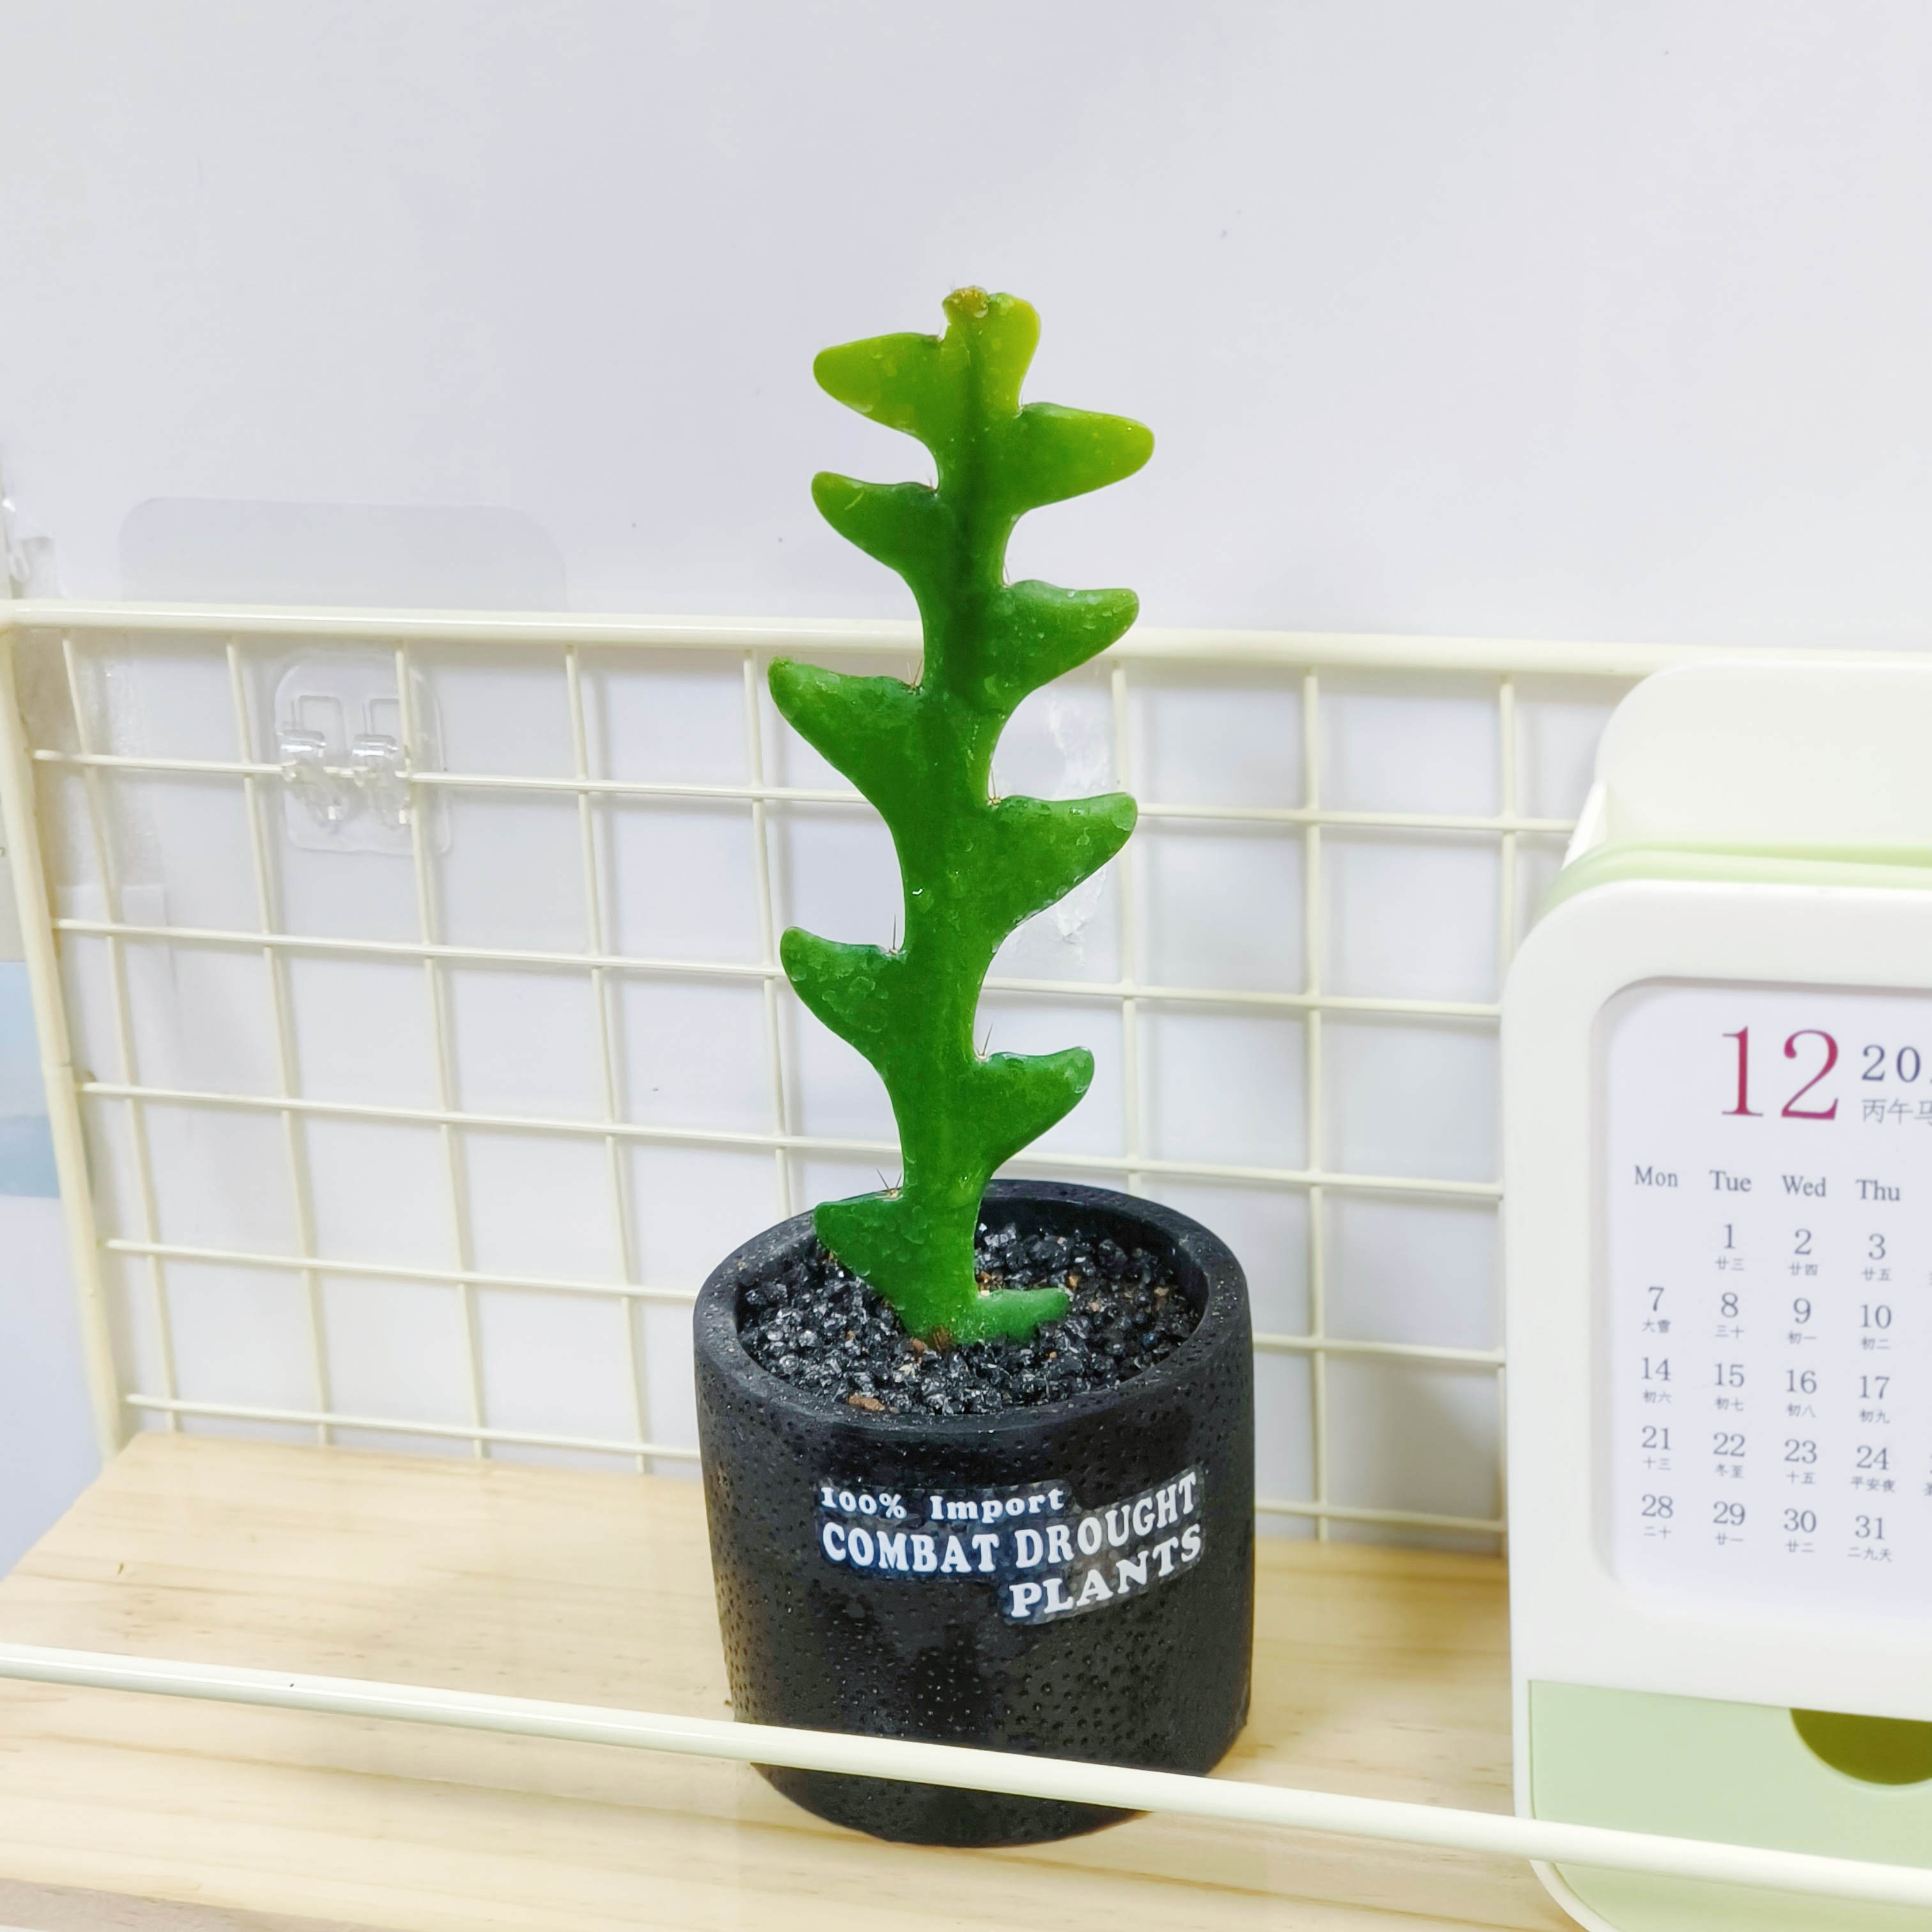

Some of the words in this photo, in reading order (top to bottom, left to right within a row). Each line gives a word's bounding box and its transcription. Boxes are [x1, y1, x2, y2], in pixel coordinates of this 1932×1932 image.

[1721, 1025, 1840, 1122] 12
[1860, 1043, 1932, 1084] 20
[1634, 1164, 1679, 1188] Mon
[1708, 1169, 1752, 1193] Tue
[1781, 1174, 1827, 1198] Wed
[1855, 1178, 1901, 1202] Thu
[1723, 1223, 1736, 1250] 1
[1793, 1227, 1813, 1256] 2
[1867, 1232, 1887, 1261] 3
[1647, 1285, 1666, 1313] 7
[1720, 1291, 1739, 1319] 8
[1792, 1297, 1812, 1325] 9
[1860, 1303, 1893, 1330] 10
[1715, 1324, 1745, 1339] 三十
[1786, 1330, 1817, 1345] 初一
[1860, 1335, 1890, 1351] 初二
[1641, 1356, 1671, 1383] 14
[1714, 1362, 1745, 1388] 15
[1786, 1368, 1818, 1395] 16
[1859, 1374, 1891, 1400] 17
[1714, 1395, 1744, 1412] 初七
[1786, 1402, 1816, 1418] 初八
[1859, 1408, 1890, 1424] 初九
[1641, 1425, 1672, 1451] 21
[1712, 1432, 1746, 1458] 22
[1783, 1438, 1818, 1465] 23
[1855, 1445, 1890, 1471] 24
[1643, 1455, 1671, 1471] 十三
[1714, 1462, 1744, 1479] 冬至
[1786, 1470, 1815, 1485] 十五
[1850, 1476, 1896, 1493] 平安夜
[820, 1486, 907, 1519] 100%
[929, 1489, 1064, 1524] Import
[822, 1521, 1000, 1574] COMBAT
[1013, 1471, 1197, 1569] DROUGHT
[1641, 1493, 1674, 1519] 28
[1712, 1500, 1747, 1527] 29
[1783, 1507, 1818, 1534] 30
[1854, 1514, 1885, 1540] 31
[1643, 1525, 1672, 1540] 二十
[1008, 1523, 1202, 1618] PLANTS
